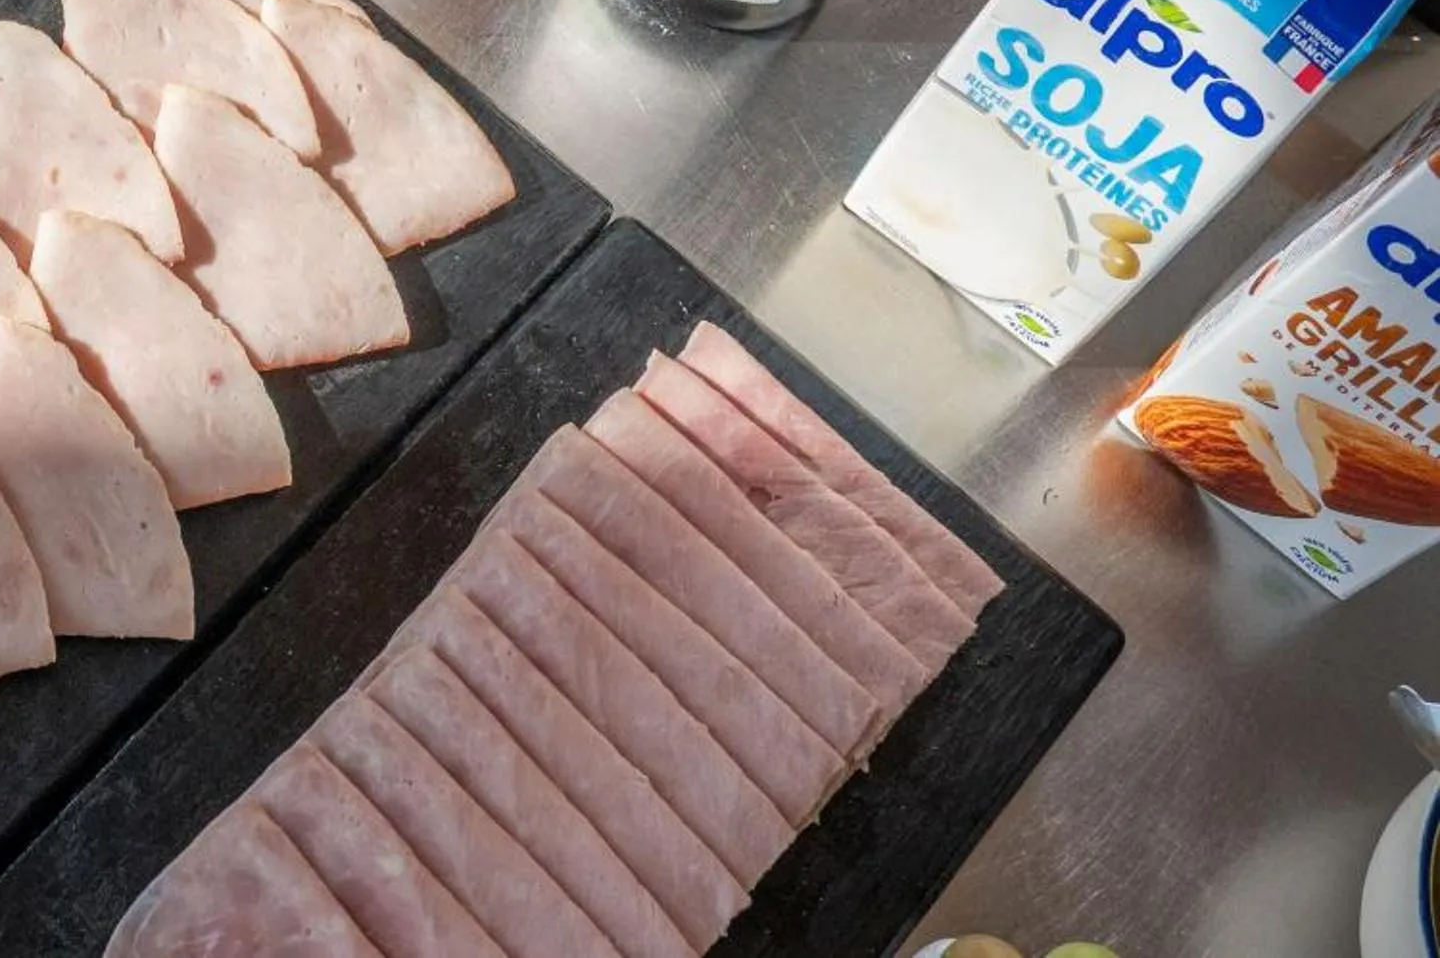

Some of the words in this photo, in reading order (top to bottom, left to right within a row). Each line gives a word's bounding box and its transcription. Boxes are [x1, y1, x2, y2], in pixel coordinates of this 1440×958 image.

[964, 72, 1013, 110] RICHE
[1283, 24, 1332, 72] FRANCE
[976, 26, 1205, 216] SOJA
[1007, 108, 1170, 233] PROTÉINES
